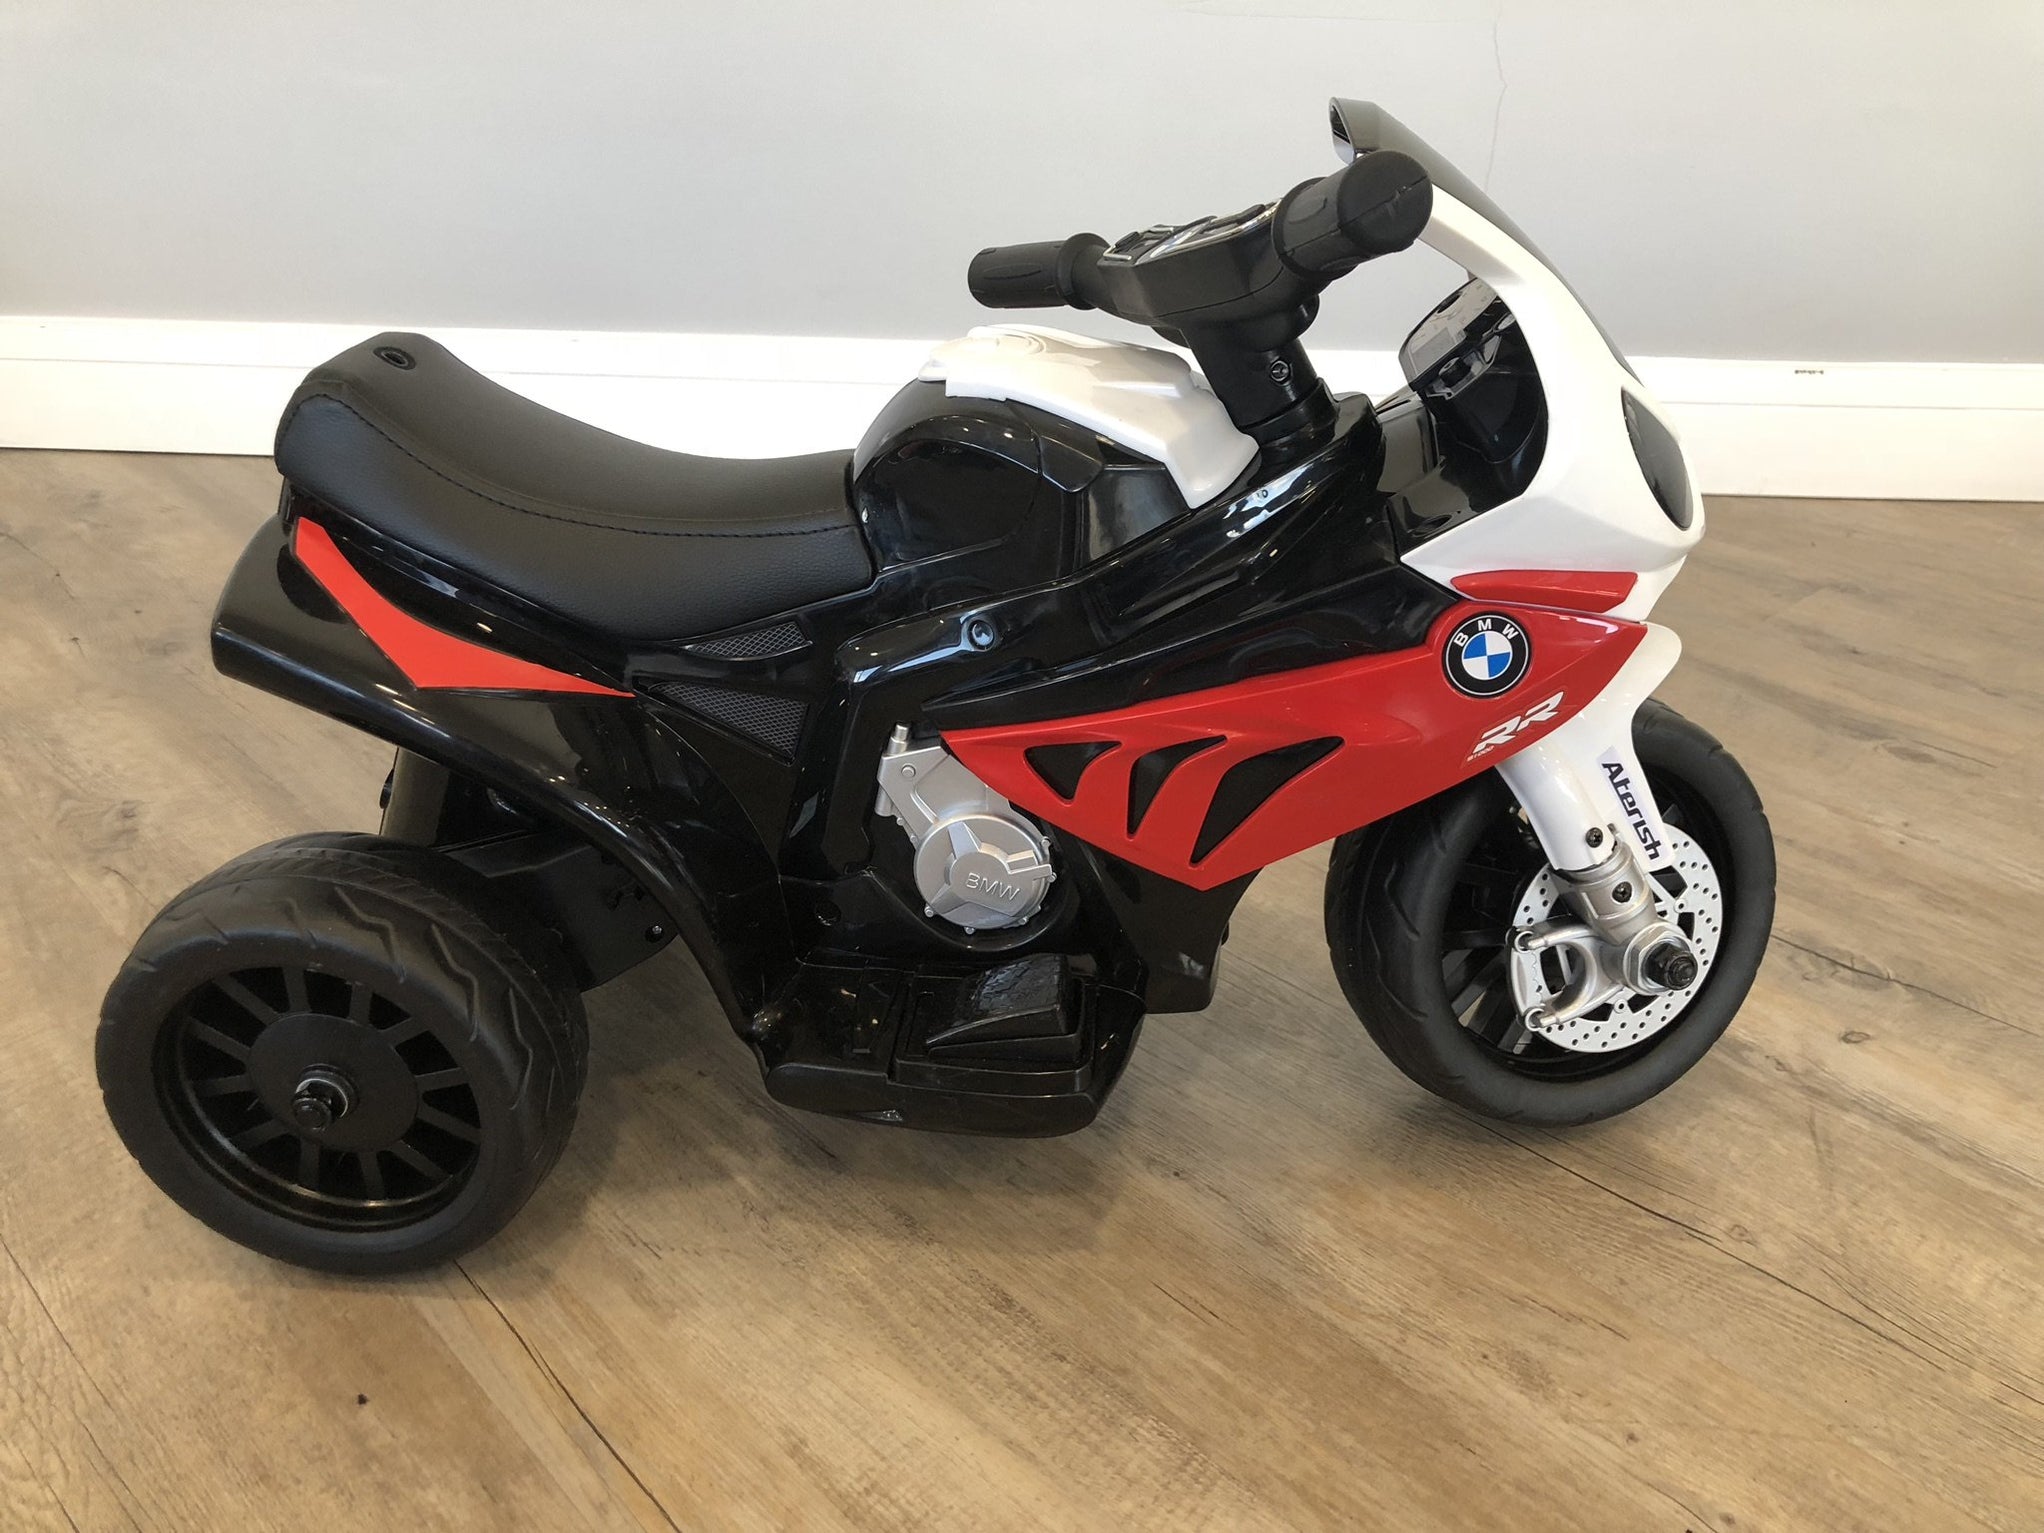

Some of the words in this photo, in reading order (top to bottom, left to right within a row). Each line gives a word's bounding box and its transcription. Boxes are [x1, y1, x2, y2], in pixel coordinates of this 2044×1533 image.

[1453, 618, 1520, 647] BMW
[1472, 691, 1564, 754] RR
[1601, 762, 1662, 861] Aterish
[965, 872, 1021, 901] BMW
